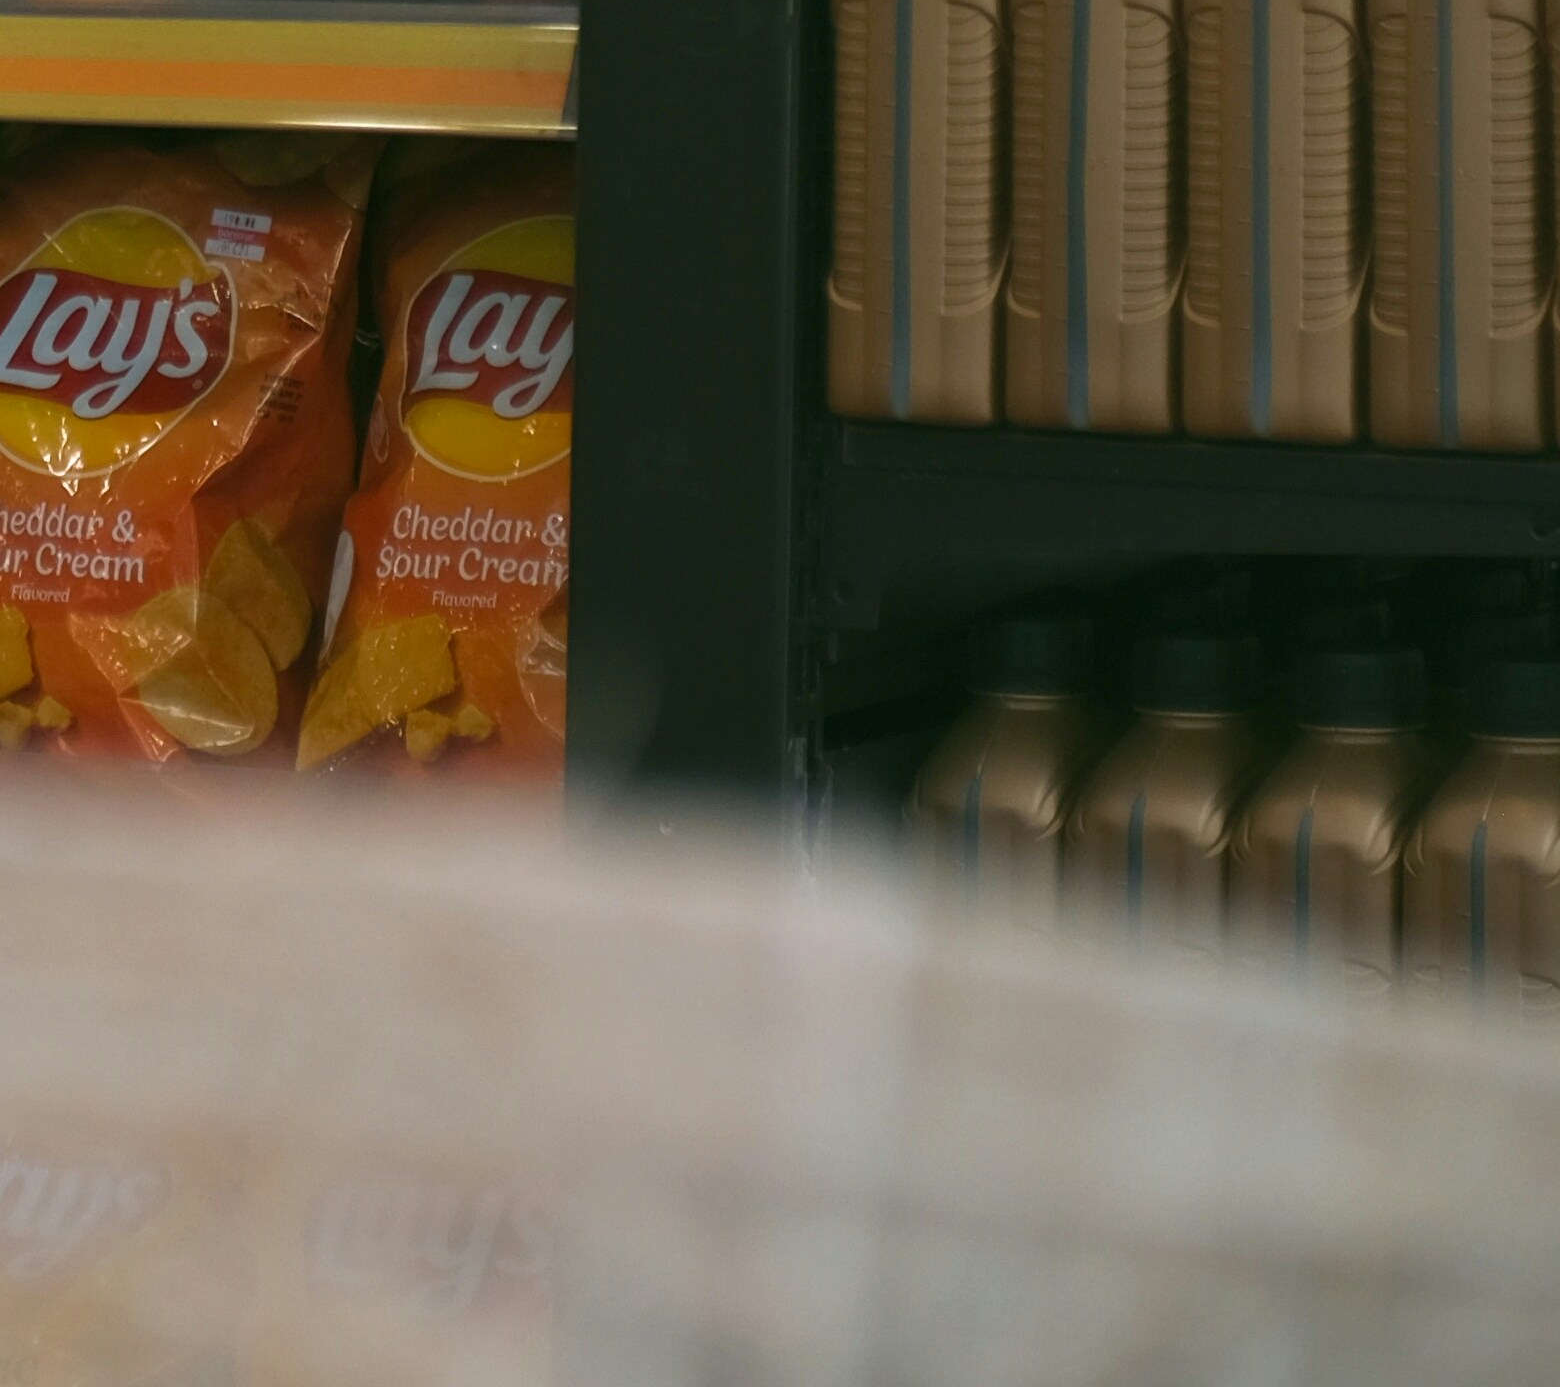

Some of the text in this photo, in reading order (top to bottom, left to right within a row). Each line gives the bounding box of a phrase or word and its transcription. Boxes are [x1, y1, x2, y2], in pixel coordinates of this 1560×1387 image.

[411, 273, 574, 419] Lay
[111, 510, 137, 544] &
[391, 504, 569, 548] Cheddar &
[34, 541, 145, 584] Cream
[376, 543, 452, 582] Sour
[10, 583, 71, 604] Flavored
[431, 590, 497, 611] Flavored
